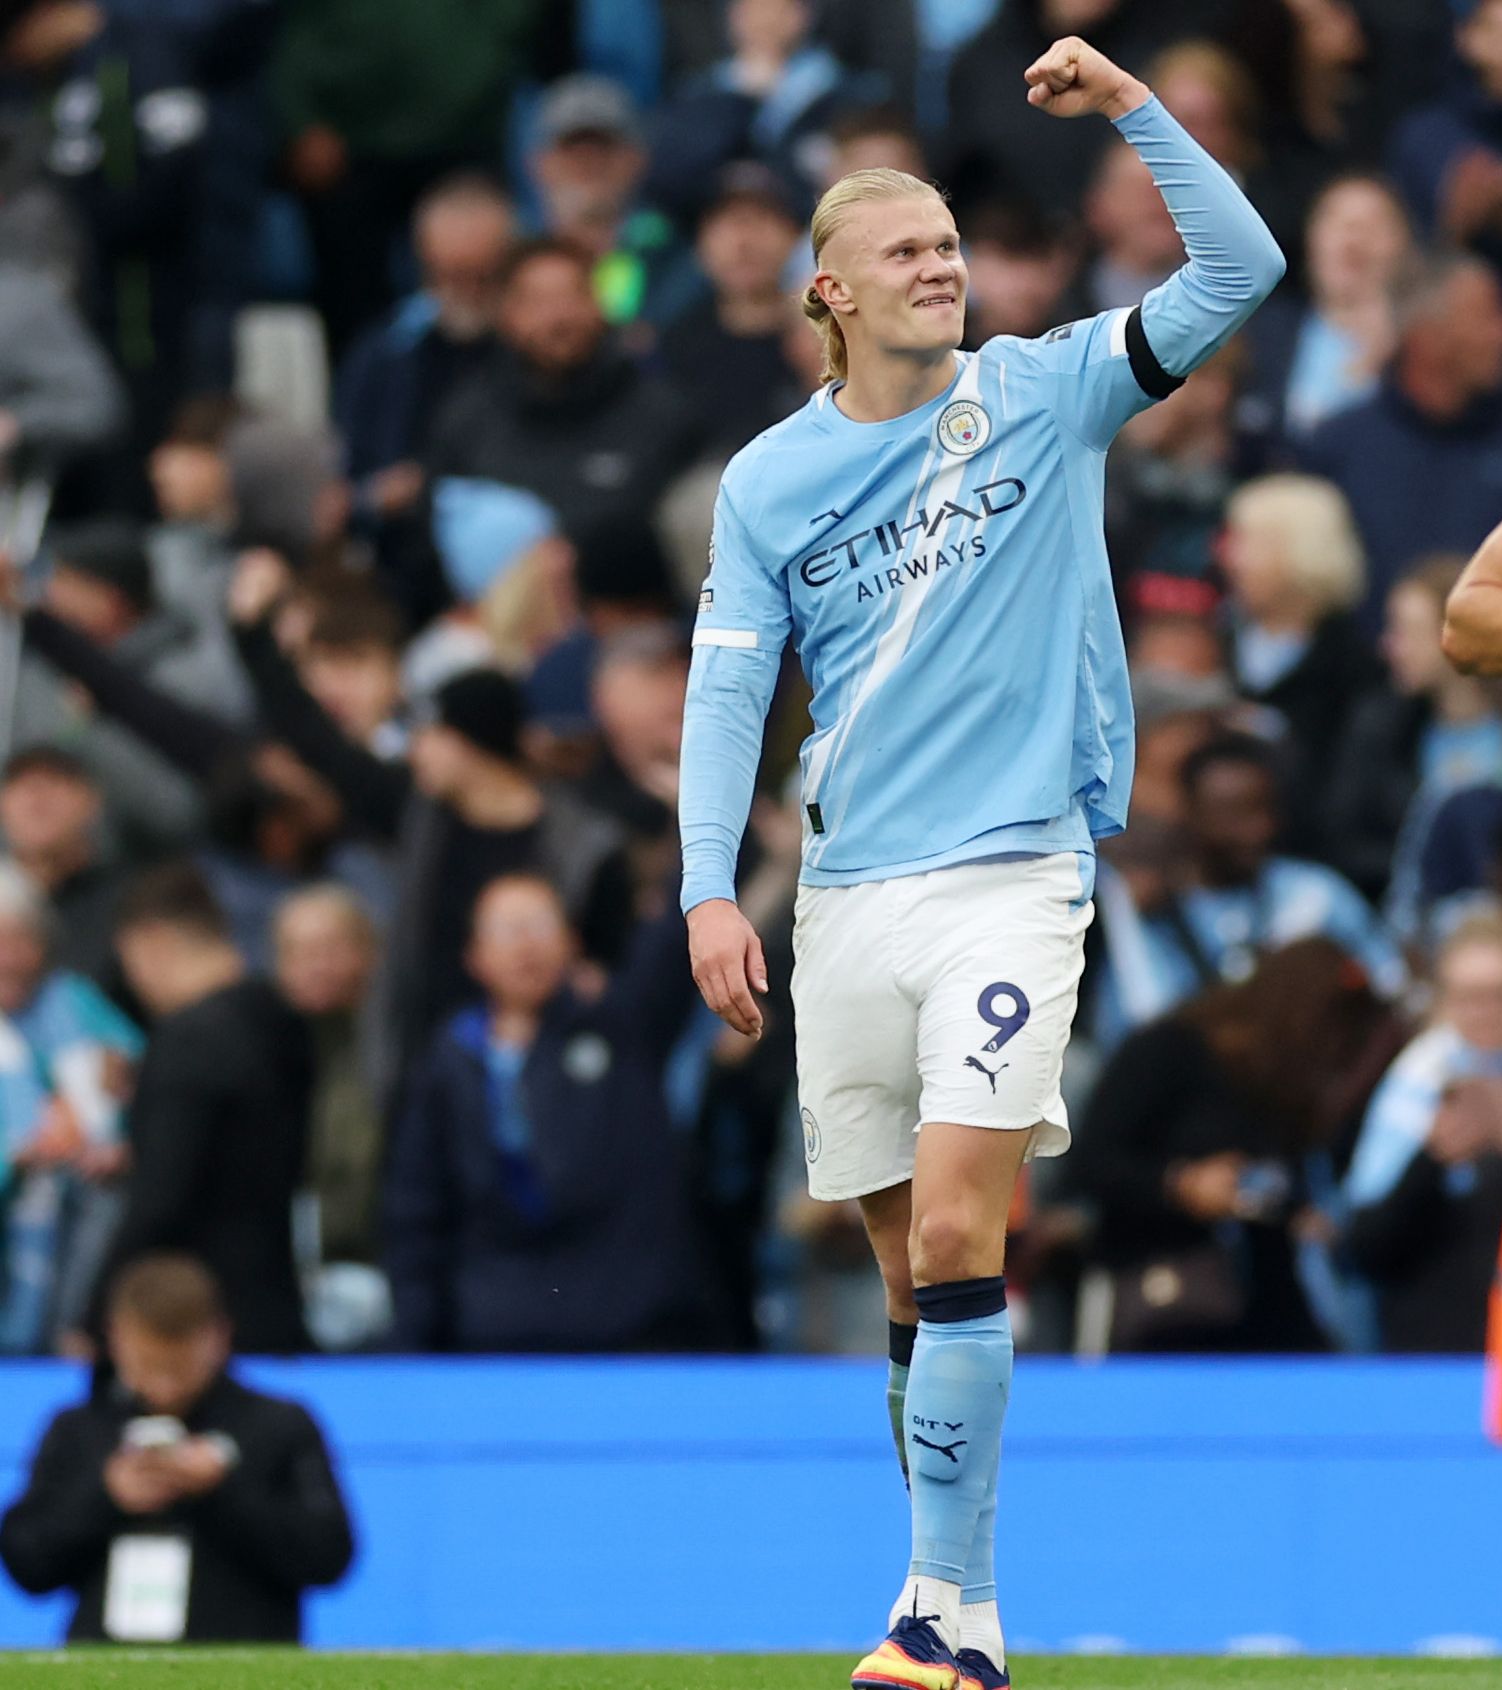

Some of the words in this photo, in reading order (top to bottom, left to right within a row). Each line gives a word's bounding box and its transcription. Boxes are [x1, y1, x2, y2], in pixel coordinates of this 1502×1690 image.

[799, 477, 1027, 588] ETIHAD
[856, 535, 987, 604] AIRWAYS
[977, 981, 1030, 1053] 9
